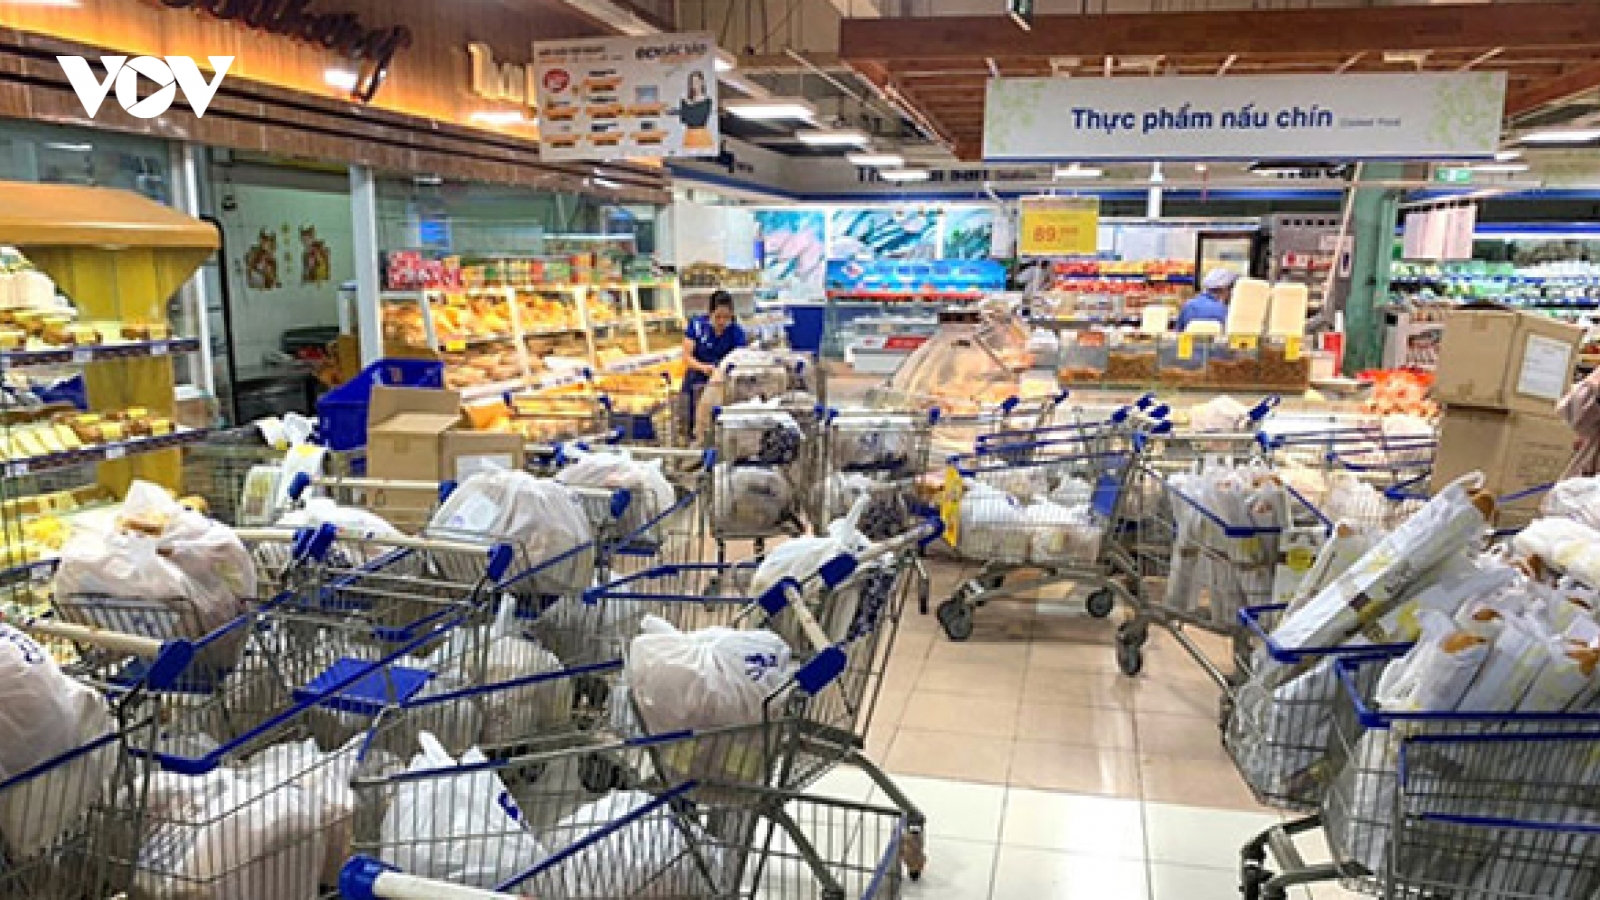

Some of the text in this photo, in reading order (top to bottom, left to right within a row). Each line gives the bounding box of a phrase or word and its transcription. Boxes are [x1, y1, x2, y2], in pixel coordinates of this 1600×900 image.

[1071, 106, 1136, 134] Thực
[1142, 101, 1215, 134] phẩm
[1220, 100, 1269, 129] nấu
[1275, 102, 1333, 129] chín
